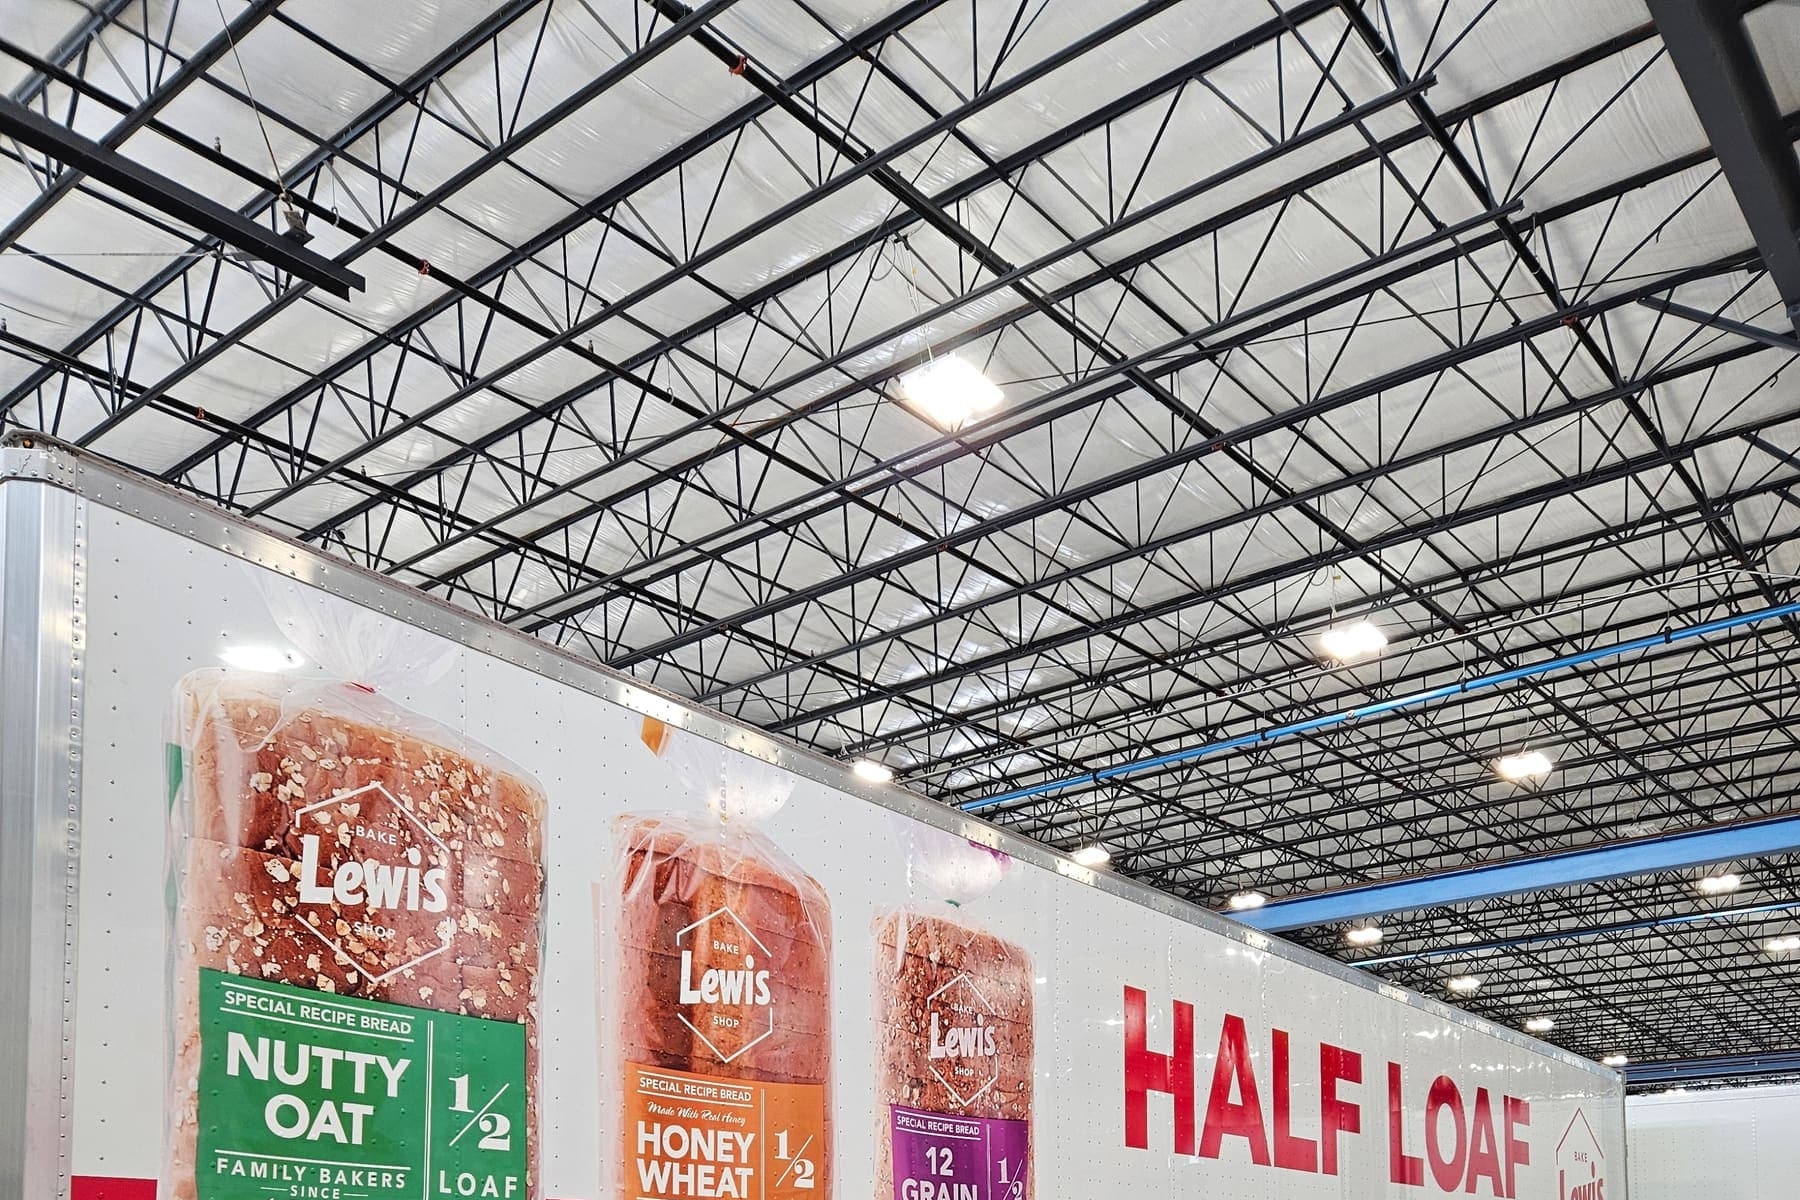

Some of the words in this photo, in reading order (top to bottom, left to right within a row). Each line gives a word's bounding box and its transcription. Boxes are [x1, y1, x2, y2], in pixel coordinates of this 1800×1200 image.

[356, 825, 397, 846] BAKE
[300, 833, 448, 913] Lewis
[353, 921, 396, 939] SHOP
[713, 940, 739, 954] BAKE
[679, 950, 771, 1006] Lewis
[225, 991, 295, 1016] SPECIAL
[300, 1005, 356, 1026] RECIPE
[361, 1016, 412, 1034] BREAD
[712, 1015, 739, 1028] SHOP
[930, 1012, 996, 1059] Lewis
[226, 1031, 412, 1098] NUTTY
[954, 1066, 974, 1077] SHOP
[639, 1077, 681, 1093] SPECIAL
[684, 1086, 718, 1098] RECIPE
[720, 1090, 752, 1102] BREAD
[1124, 985, 1362, 1176] HALF
[1388, 1061, 1531, 1200] LOAF
[264, 1093, 374, 1145] OAT
[647, 1101, 674, 1116] Made
[678, 1106, 698, 1119] With
[701, 1110, 720, 1122] Real
[896, 1115, 926, 1130] SPECIAL
[927, 1122, 954, 1133] RECIPE
[955, 1126, 980, 1136] BREAD
[637, 1120, 756, 1164] HONEY
[216, 1158, 306, 1181] FAMILY
[319, 1168, 406, 1188] BAKERS
[925, 1146, 954, 1177] 12
[290, 1185, 340, 1199] SINCE
[439, 1170, 517, 1199] LOAF
[636, 1158, 754, 1199] WHEAT
